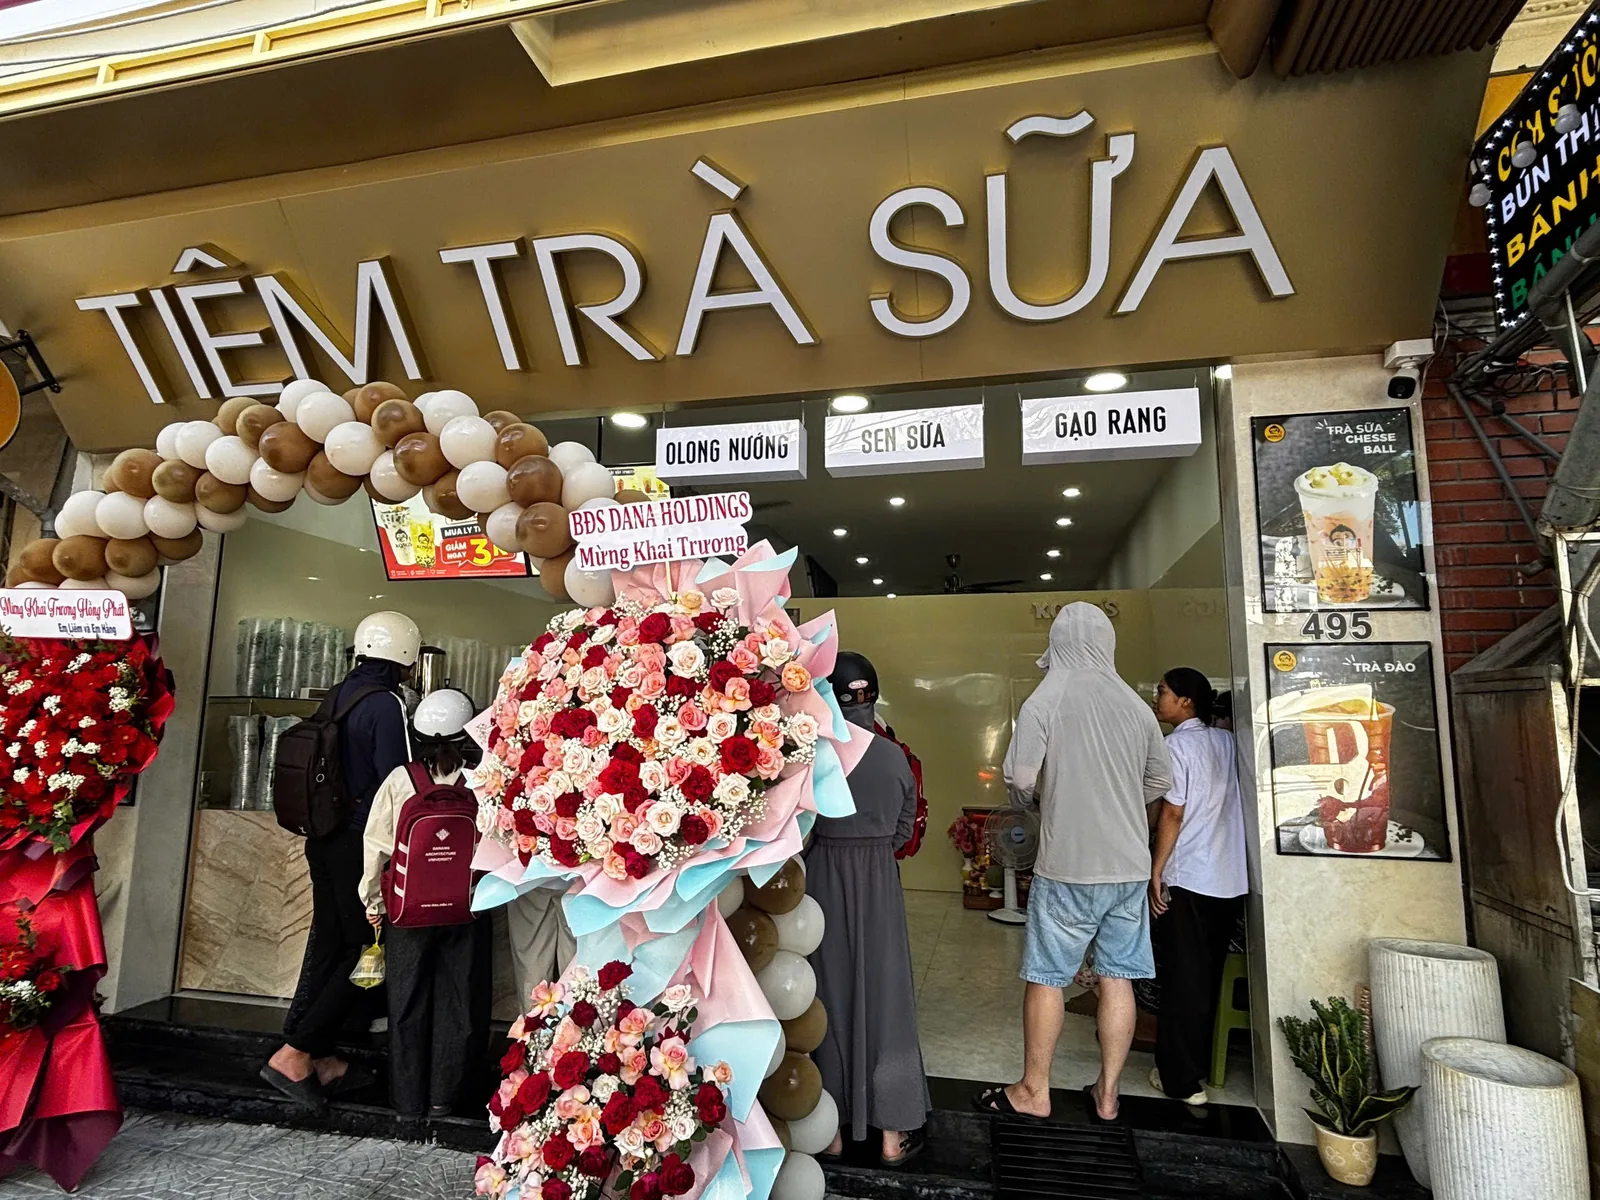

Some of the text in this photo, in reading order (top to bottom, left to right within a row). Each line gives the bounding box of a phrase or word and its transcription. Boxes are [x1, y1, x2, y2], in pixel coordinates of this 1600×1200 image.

[1501, 154, 1550, 225] BÚN
[439, 159, 818, 371] TRÀ
[869, 110, 1295, 338] SỮA
[1055, 406, 1166, 441] GẠO RANG
[1326, 422, 1384, 435] TRÀ SỮA
[861, 420, 946, 454] SEN SỮA
[1345, 433, 1396, 443] CHESSE
[665, 432, 789, 466] OLONG NƯỚNG
[1363, 445, 1396, 454] BALL
[571, 492, 750, 536] BĐS DANA HOLDINGS
[444, 528, 463, 537] MUA
[463, 526, 472, 534] LY
[445, 541, 467, 552] GIẢM
[446, 551, 467, 560] NGAY
[579, 534, 746, 570] Mừng Khai Trương
[24, 597, 47, 618] Khai
[102, 597, 125, 619] Phát
[58, 622, 68, 633] Em
[91, 623, 101, 634] Em
[1302, 612, 1373, 640] 495
[1353, 659, 1416, 673] TRÀ ĐÀO
